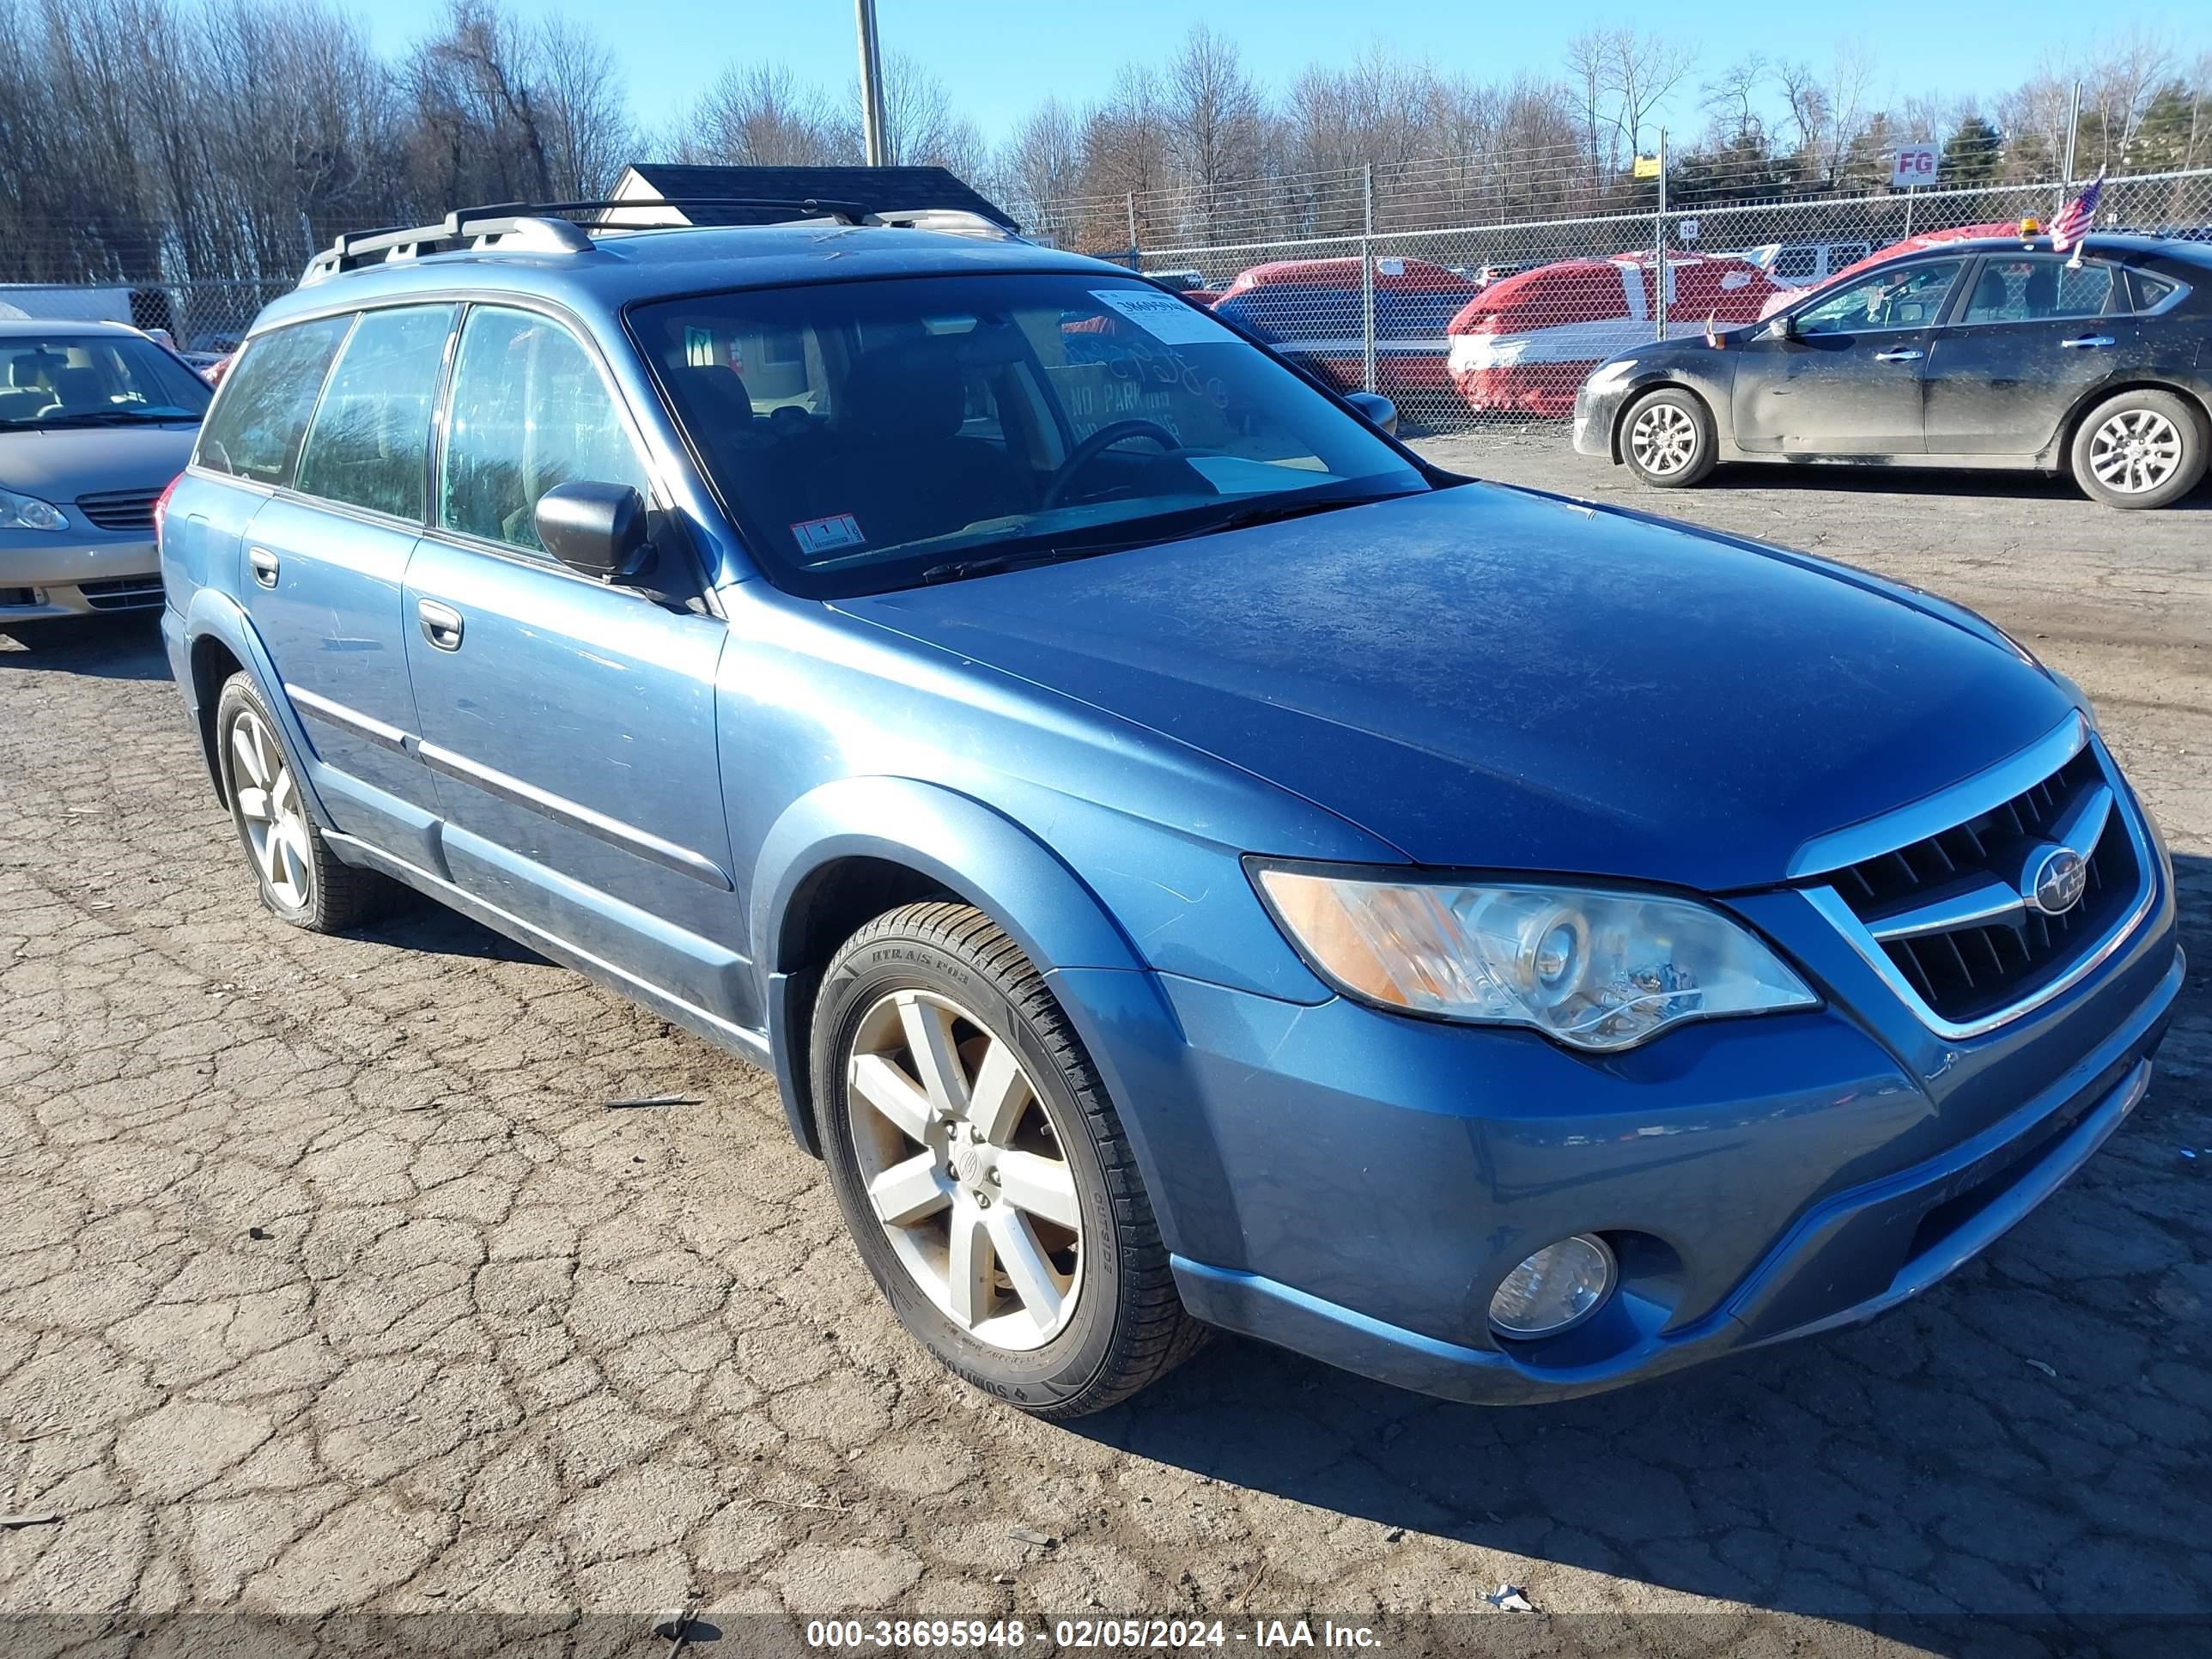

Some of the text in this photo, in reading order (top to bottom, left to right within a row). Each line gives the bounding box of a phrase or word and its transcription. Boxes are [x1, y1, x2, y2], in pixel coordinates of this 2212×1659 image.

[1899, 152, 1933, 174] FG
[1072, 386, 1093, 416] NO
[820, 524, 830, 535] 1
[1094, 1192, 1113, 1275] OUTSIDE
[927, 1341, 1009, 1400] SUMITOMO
